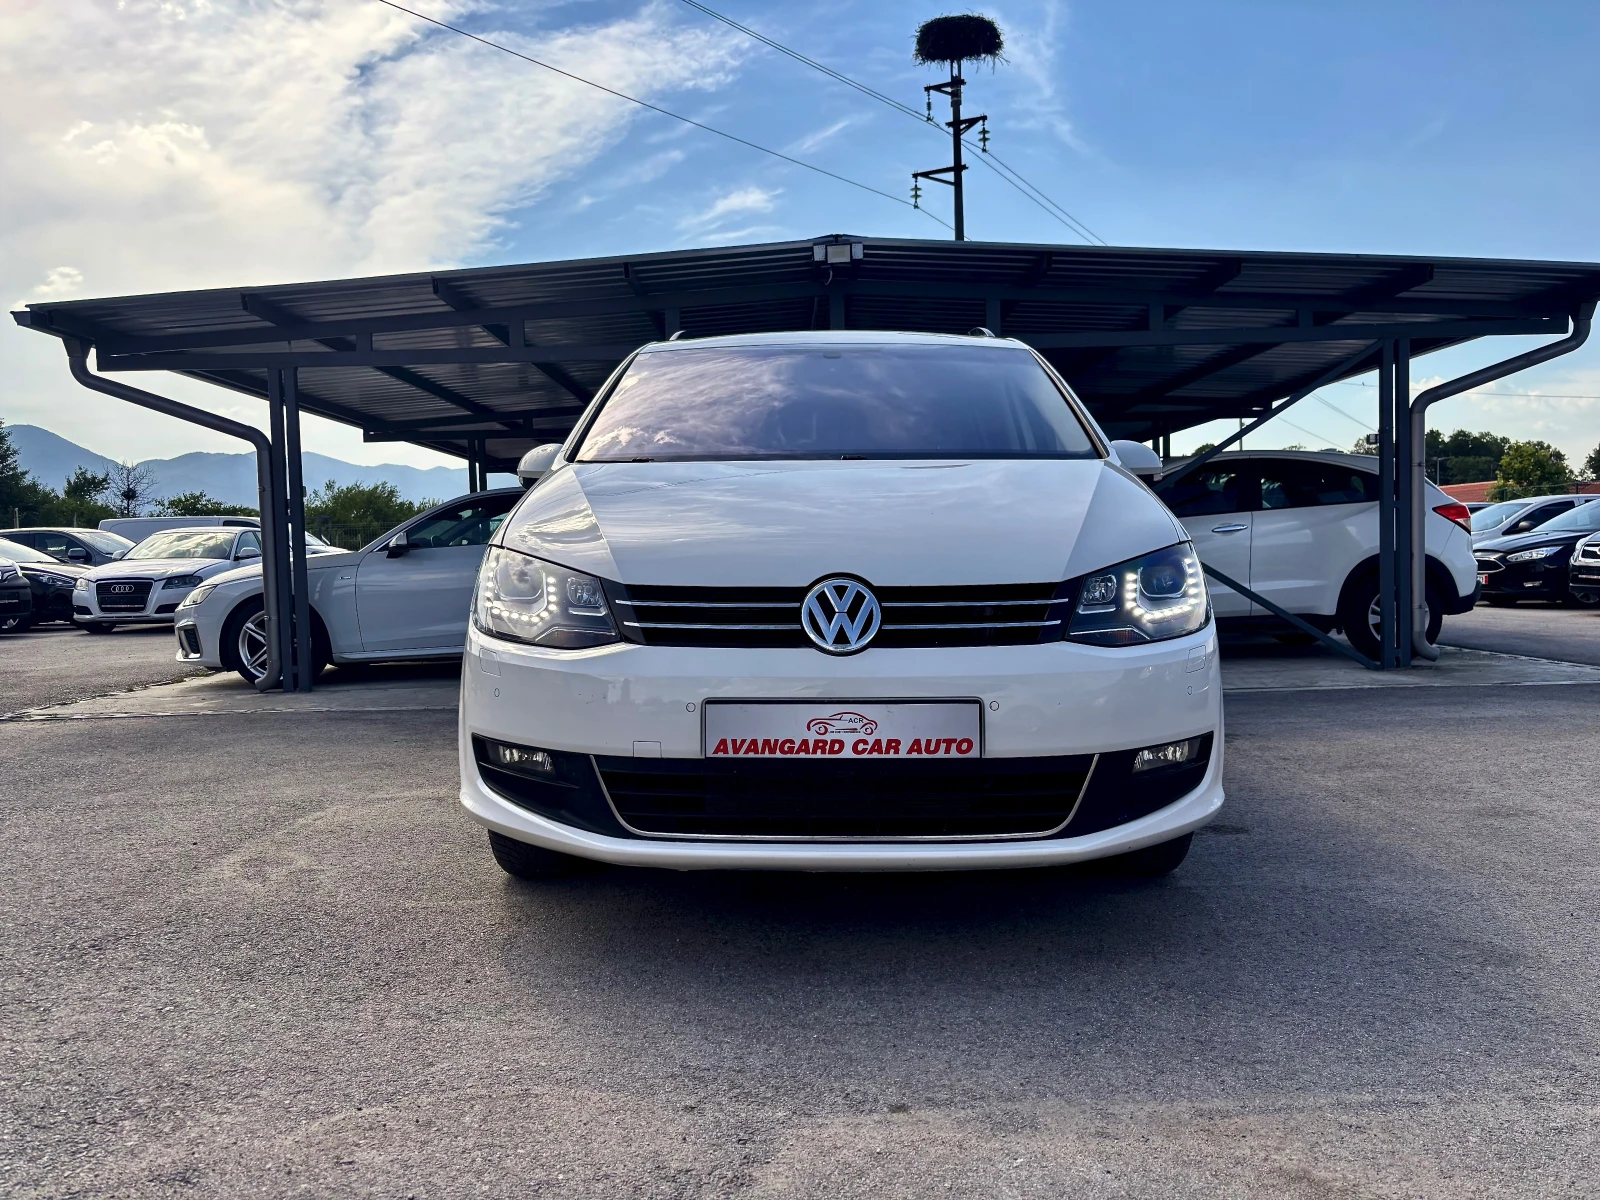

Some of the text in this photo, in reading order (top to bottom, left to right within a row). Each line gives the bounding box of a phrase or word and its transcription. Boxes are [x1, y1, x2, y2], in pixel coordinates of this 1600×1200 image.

[803, 579, 879, 649] VW
[712, 738, 974, 755] AVANGARD CAR AUTO
